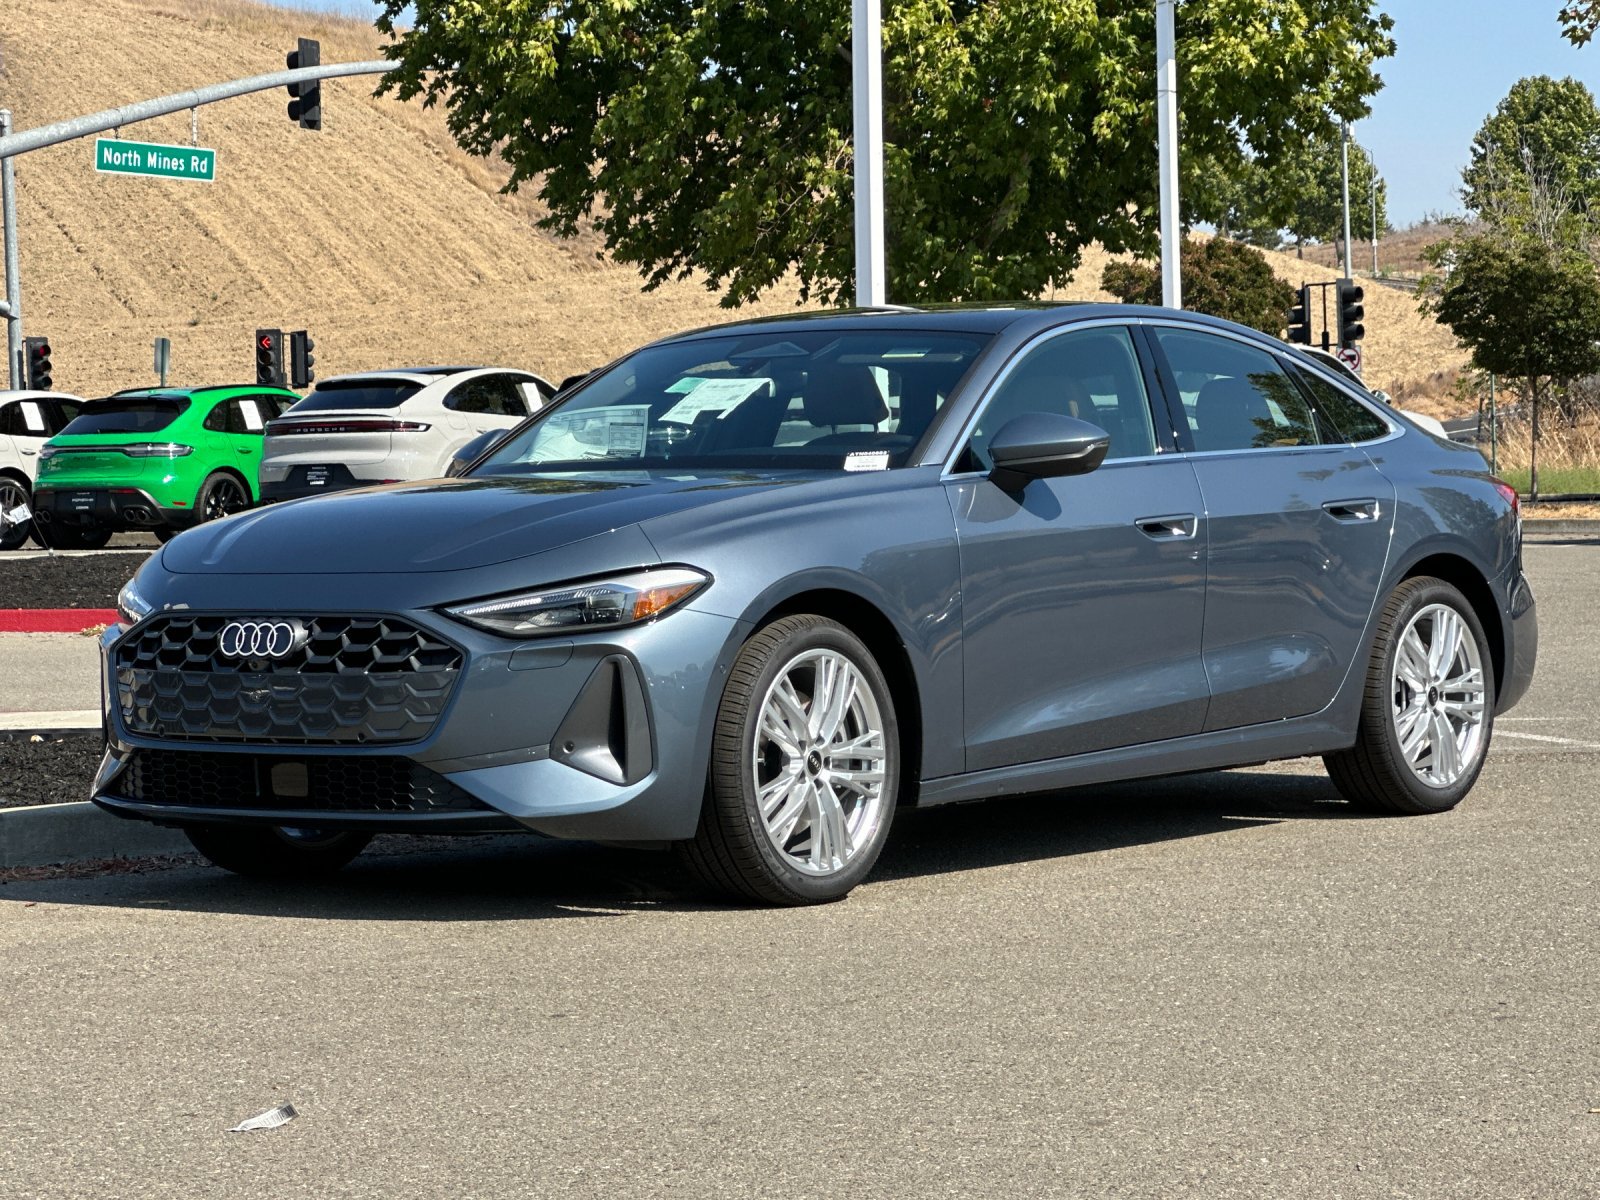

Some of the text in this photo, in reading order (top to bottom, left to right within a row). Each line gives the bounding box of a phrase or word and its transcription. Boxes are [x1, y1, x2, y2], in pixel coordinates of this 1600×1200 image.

[103, 147, 208, 174] North Mines Rd
